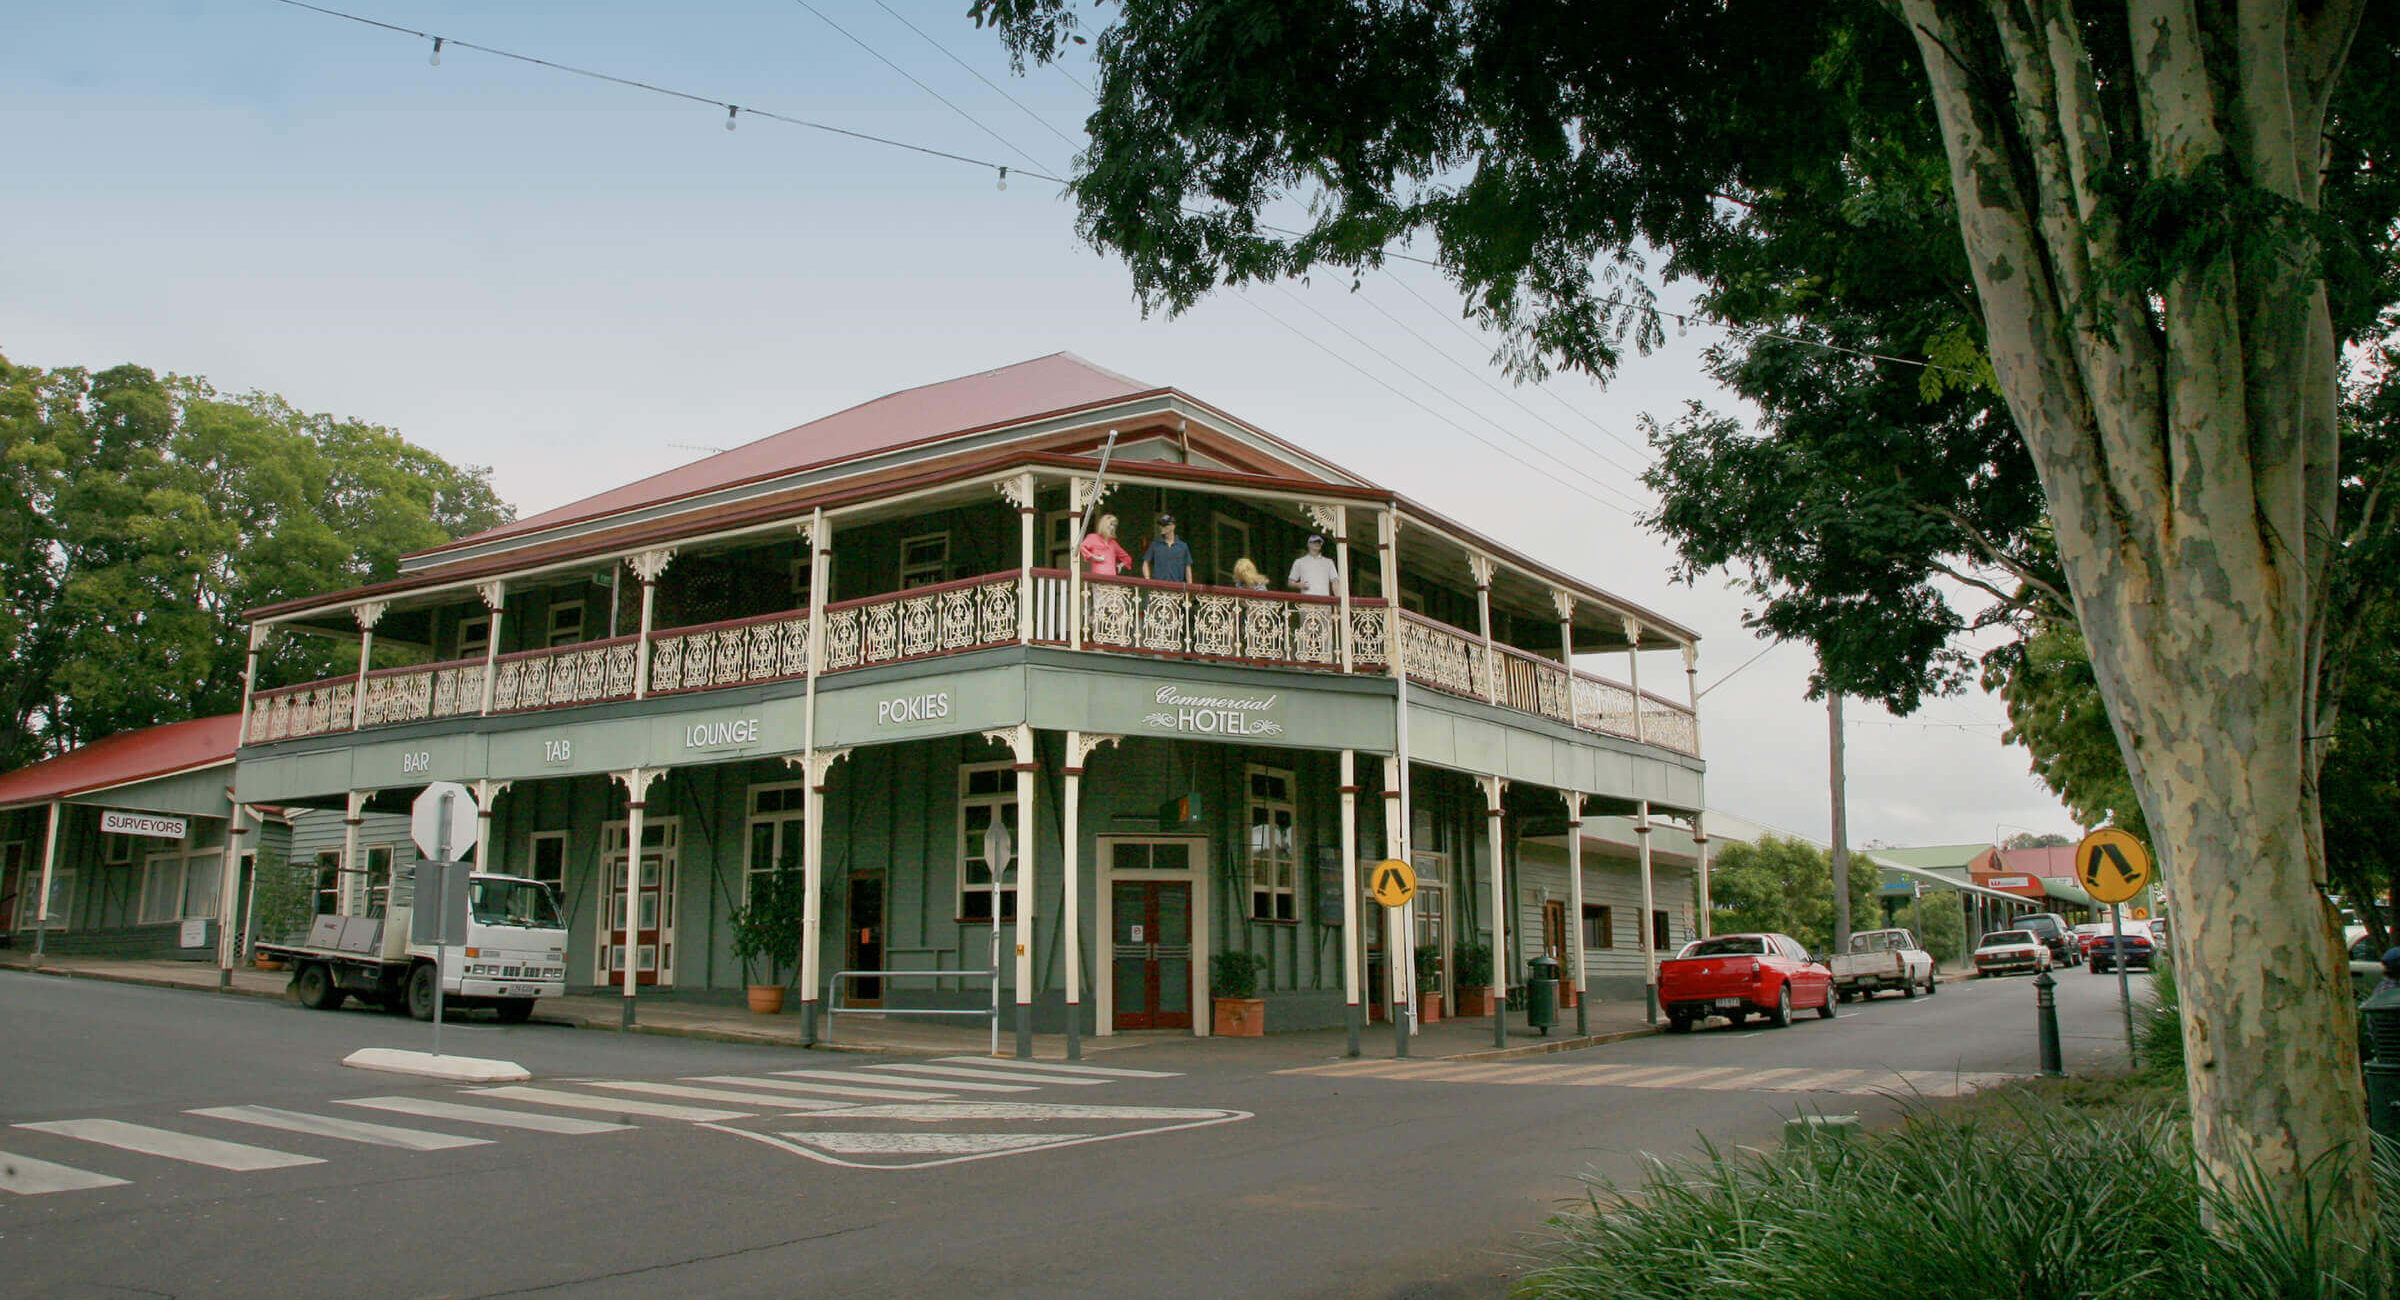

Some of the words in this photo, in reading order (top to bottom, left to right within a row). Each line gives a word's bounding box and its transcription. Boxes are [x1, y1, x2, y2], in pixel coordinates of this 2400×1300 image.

[877, 692, 949, 725] POKIES
[1155, 685, 1277, 711] Commercial
[686, 719, 759, 748] LOUNGE
[1177, 709, 1250, 735] HOTEL
[403, 752, 430, 772] BAR
[544, 740, 571, 762] TAB
[107, 815, 183, 834] SURVEYORS
